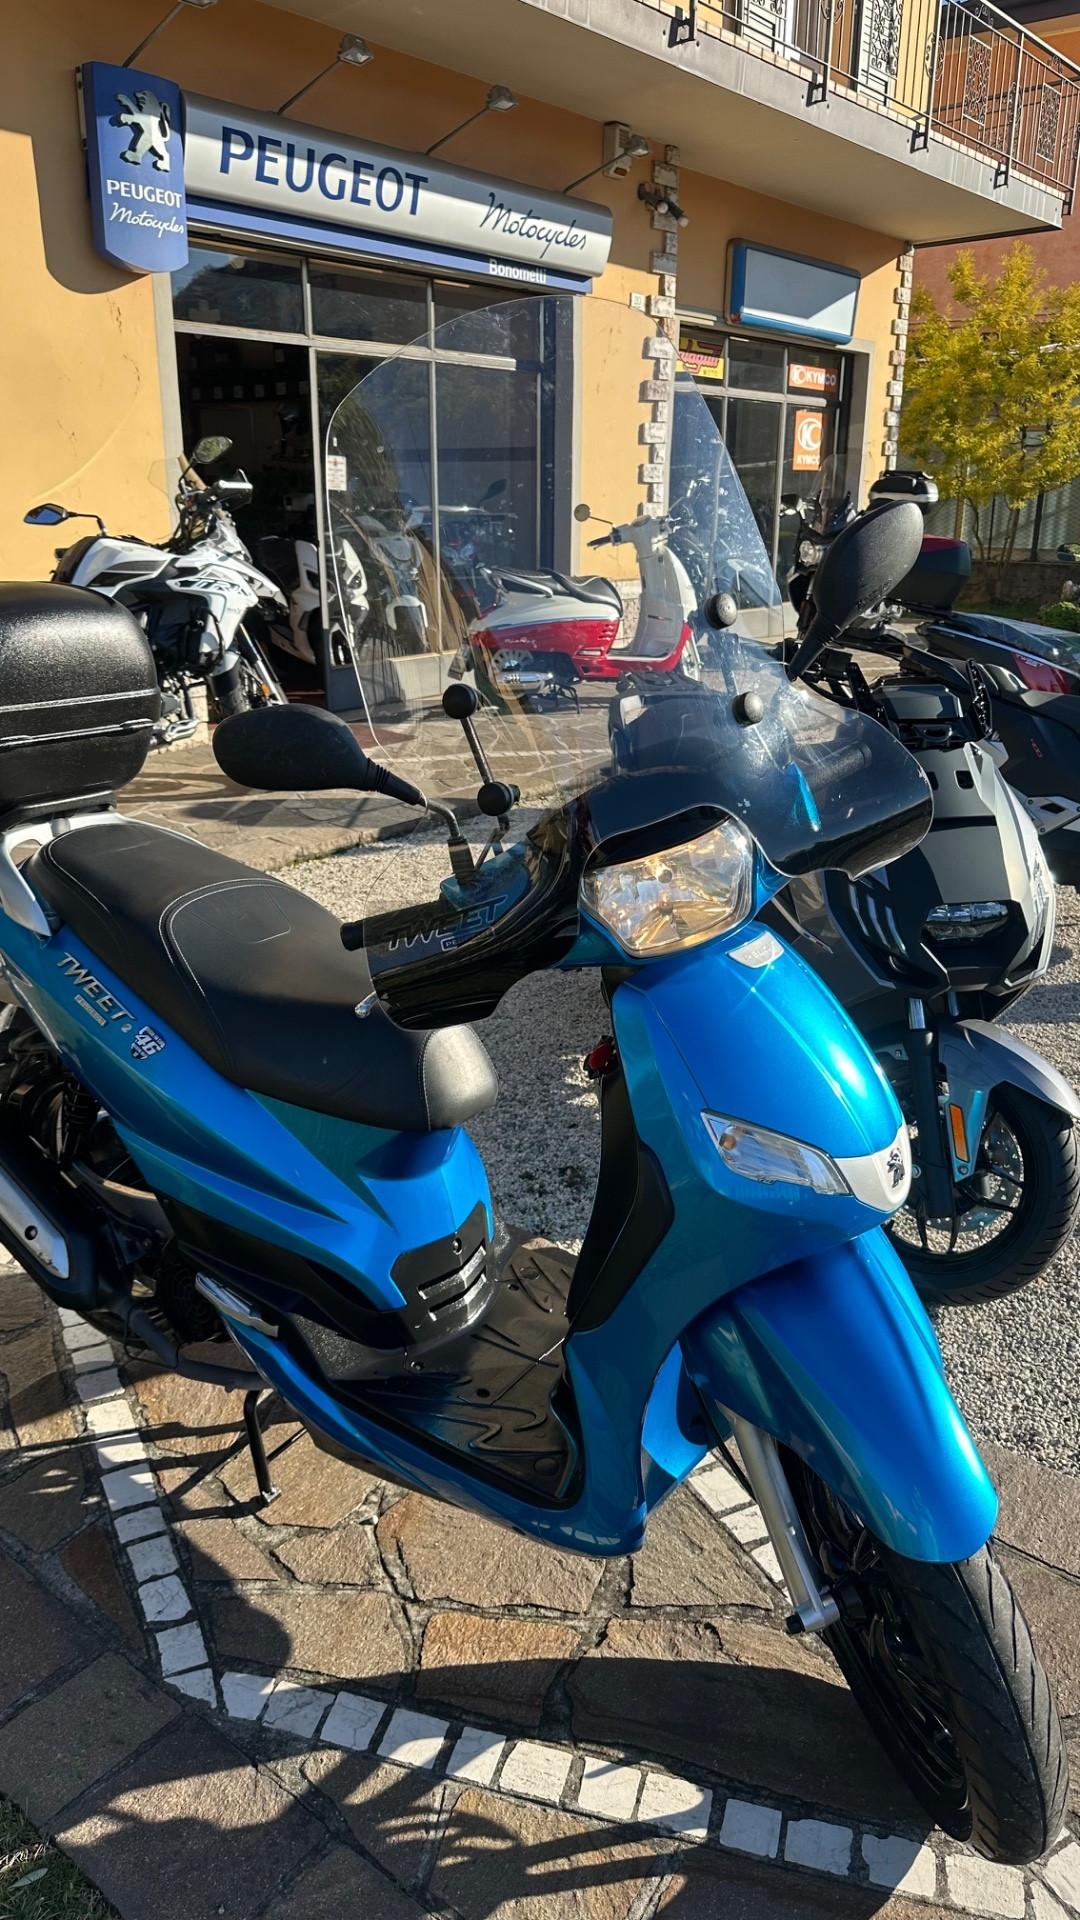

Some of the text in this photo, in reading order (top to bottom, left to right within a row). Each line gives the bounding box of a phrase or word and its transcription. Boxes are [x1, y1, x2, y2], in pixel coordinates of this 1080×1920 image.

[106, 179, 182, 208] PEUGEOT
[220, 126, 586, 259] PEUGEOT Motocycles
[110, 202, 184, 238] Motocycles
[806, 370, 836, 386] KYMCO
[57, 952, 135, 1020] TWEET
[135, 1034, 161, 1056] 46
